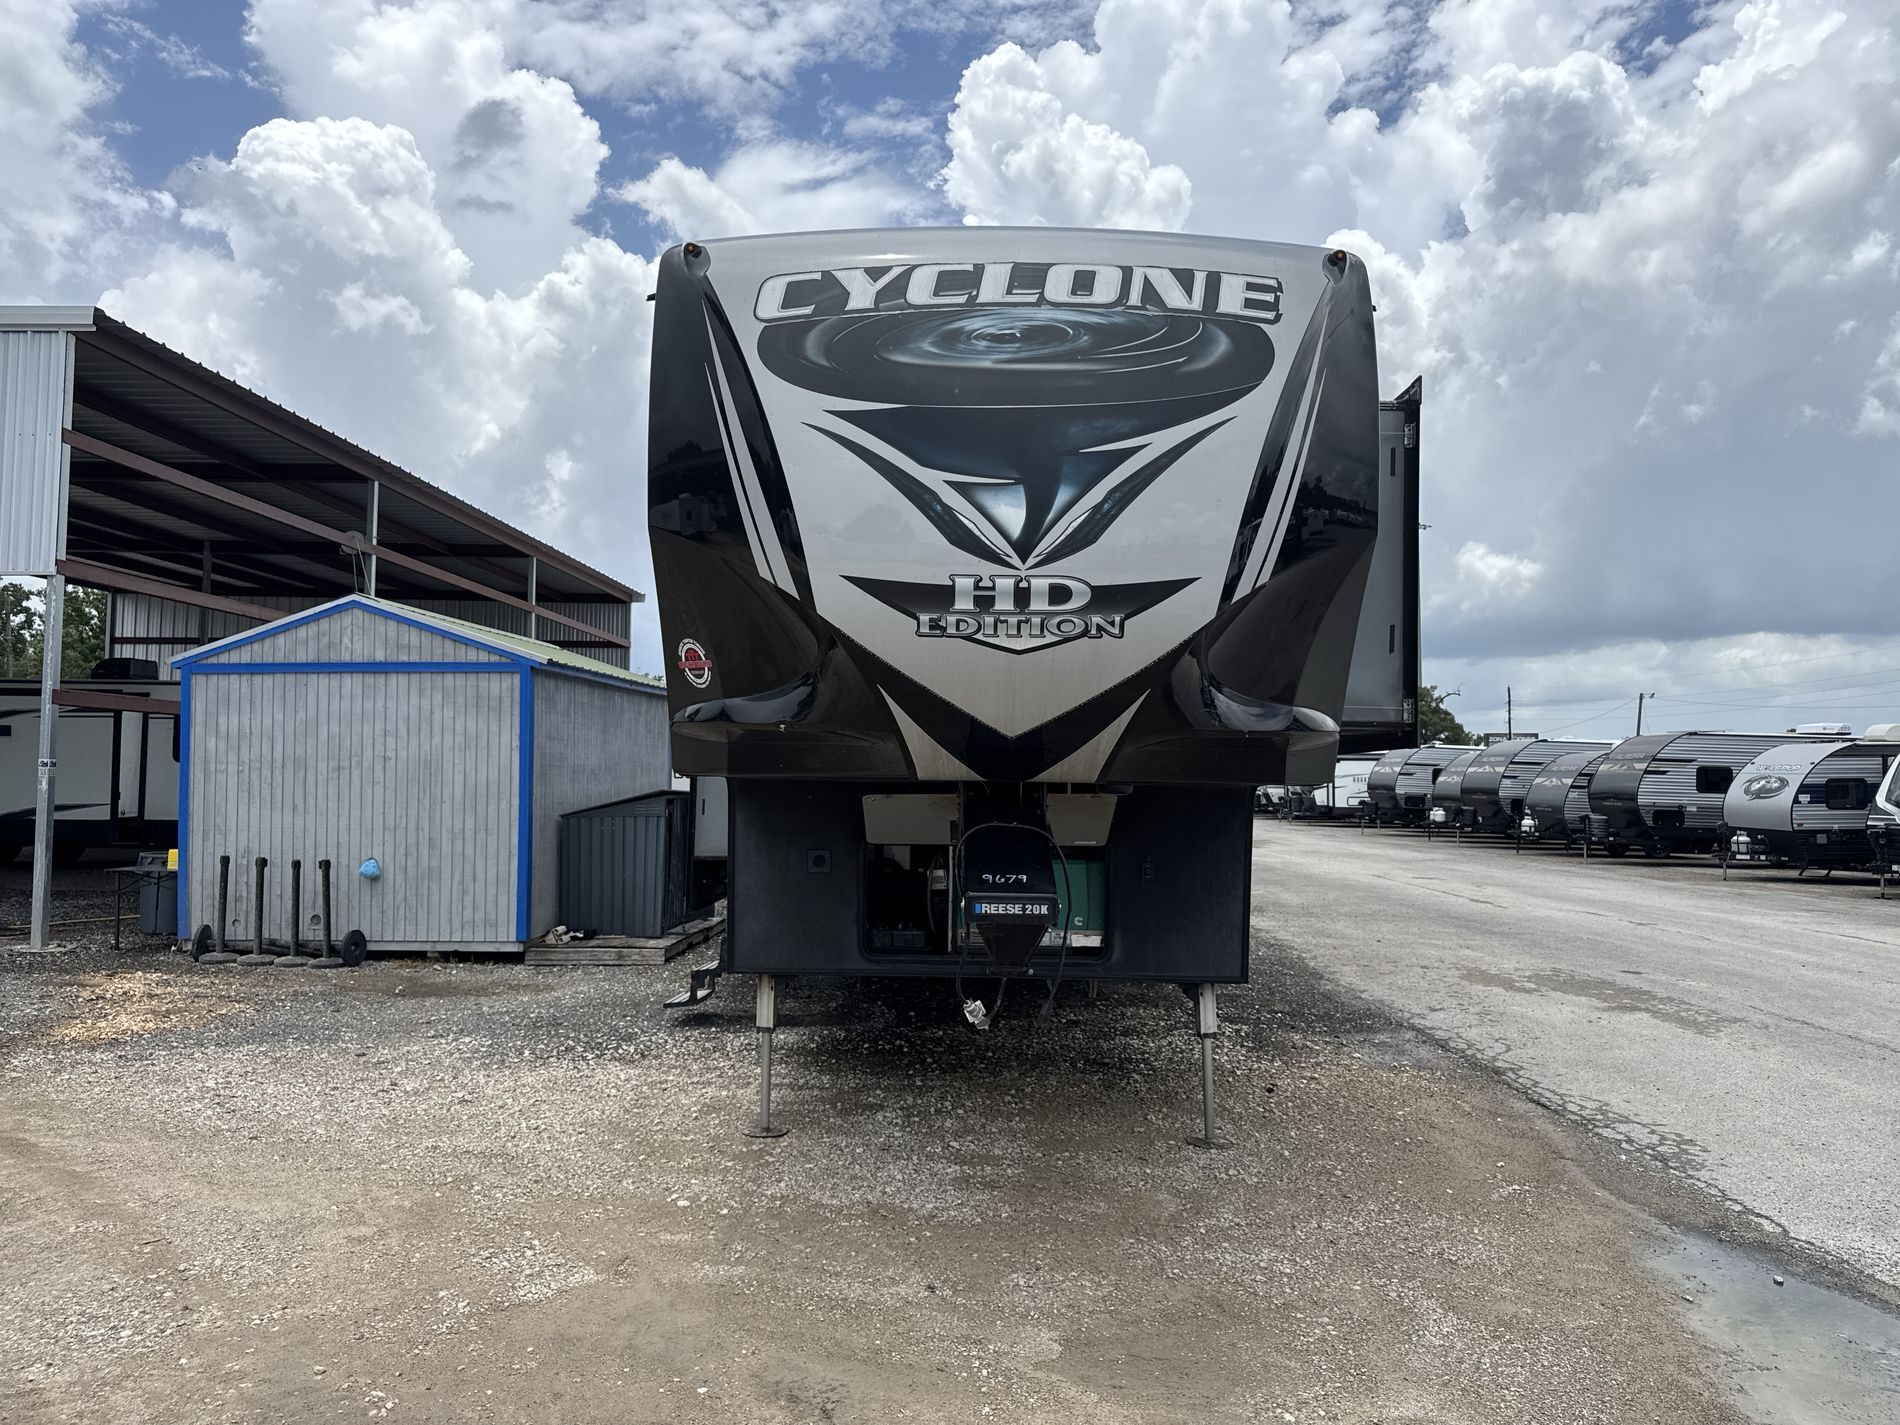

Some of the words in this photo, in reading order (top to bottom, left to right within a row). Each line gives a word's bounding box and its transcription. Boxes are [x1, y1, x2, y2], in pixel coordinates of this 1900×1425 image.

[754, 262, 1281, 322] CYCLONE
[949, 575, 1092, 613] HD
[916, 613, 1125, 638] EDITION
[981, 873, 1028, 884] 9679
[981, 903, 1023, 915] REESE
[1025, 904, 1049, 915] 20K
